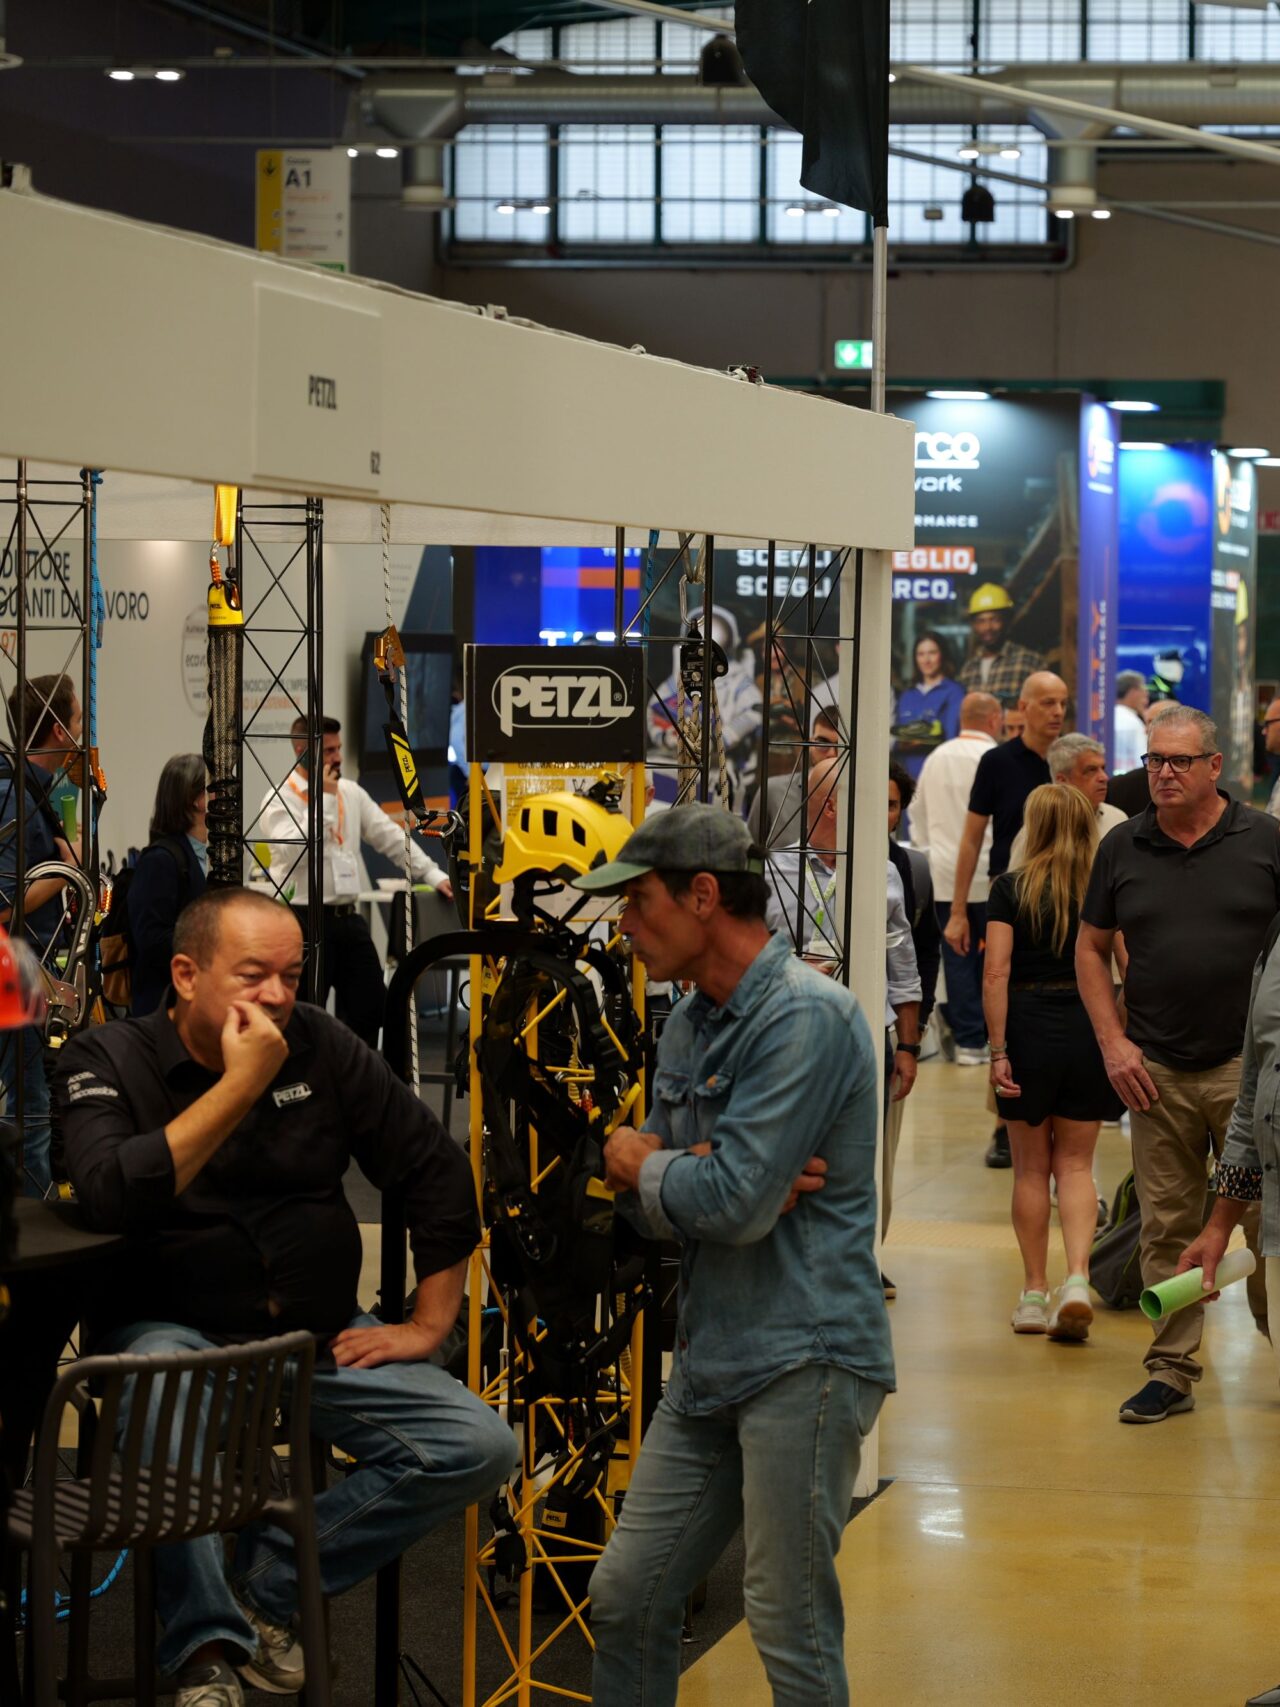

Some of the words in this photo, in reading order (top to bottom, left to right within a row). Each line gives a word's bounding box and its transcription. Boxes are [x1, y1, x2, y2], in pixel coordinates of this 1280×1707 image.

[286, 168, 311, 187] A1
[308, 374, 337, 411] PETZL
[914, 514, 979, 528] RMANCE
[892, 550, 978, 575] EGLIO,
[892, 579, 957, 600] RCO.
[105, 591, 150, 620] VORO
[499, 675, 635, 738] PETZL
[272, 1084, 313, 1109] PETZL
